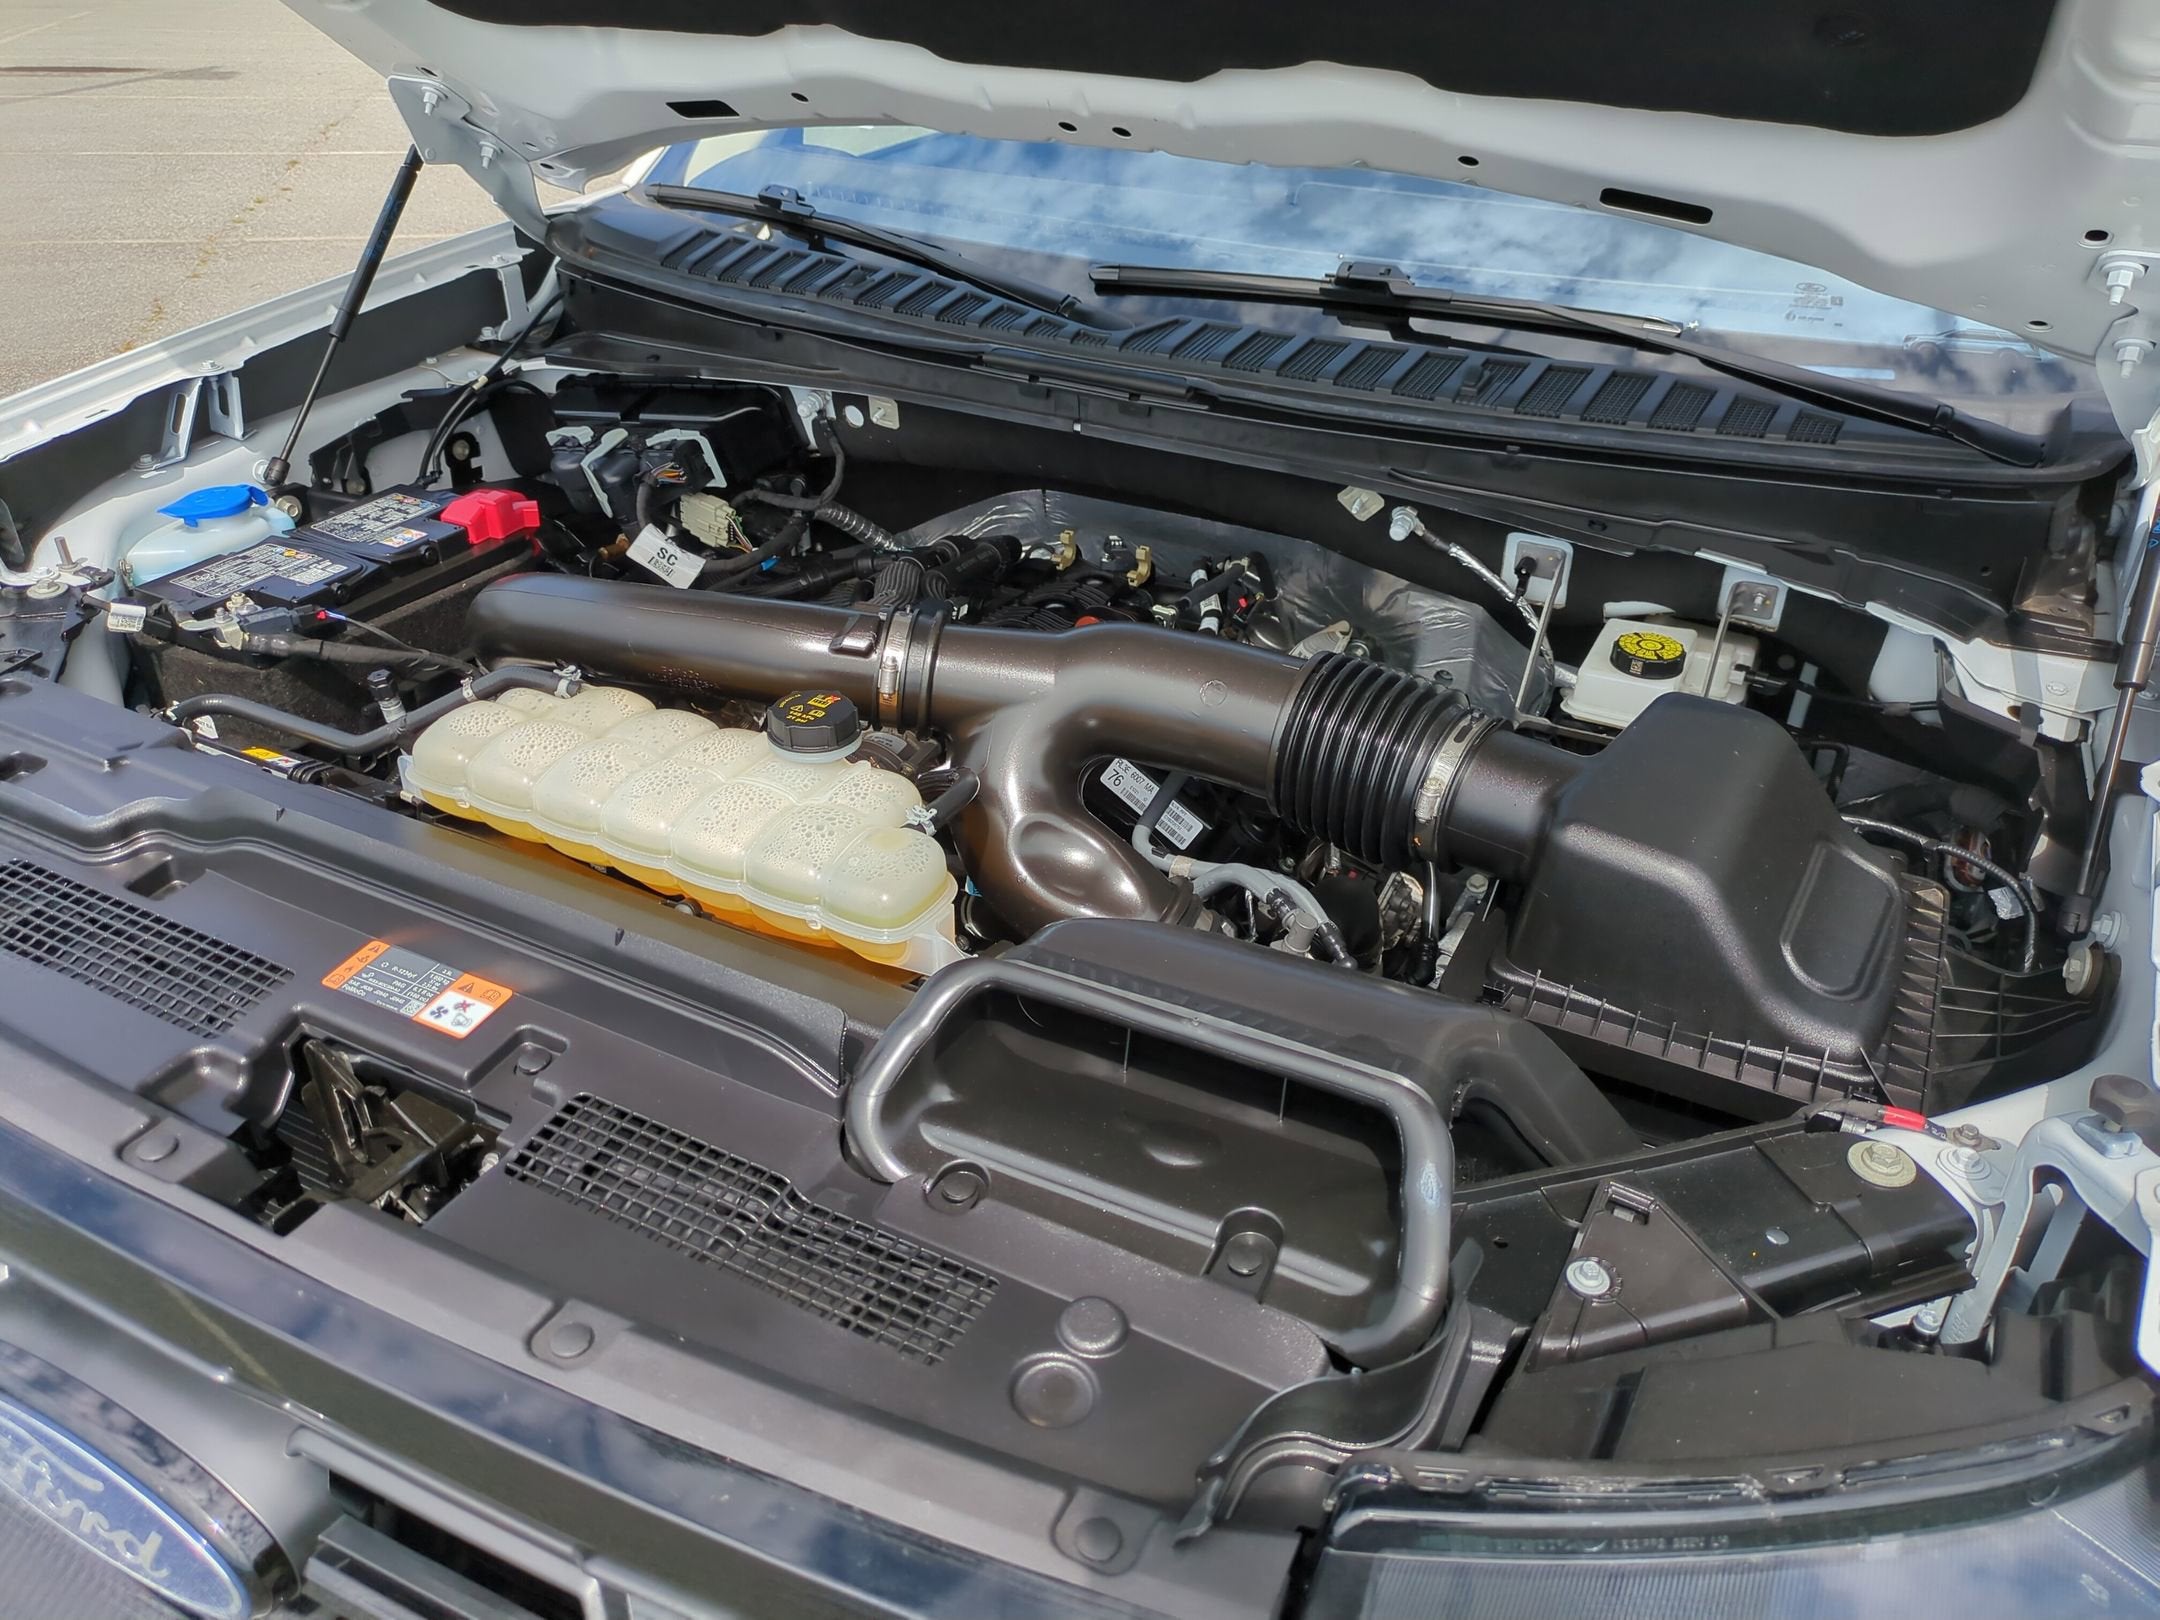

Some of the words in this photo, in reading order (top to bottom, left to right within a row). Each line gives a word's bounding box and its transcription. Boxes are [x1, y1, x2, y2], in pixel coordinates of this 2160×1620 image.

[656, 547, 678, 566] SC
[1107, 768, 1124, 787] 76
[1115, 760, 1131, 774] RL3E
[1131, 771, 1145, 785] 6007
[1144, 782, 1155, 794] MA
[342, 984, 366, 996] FoMoCo
[392, 980, 407, 988] PAG
[0, 1412, 171, 1580] Ford
